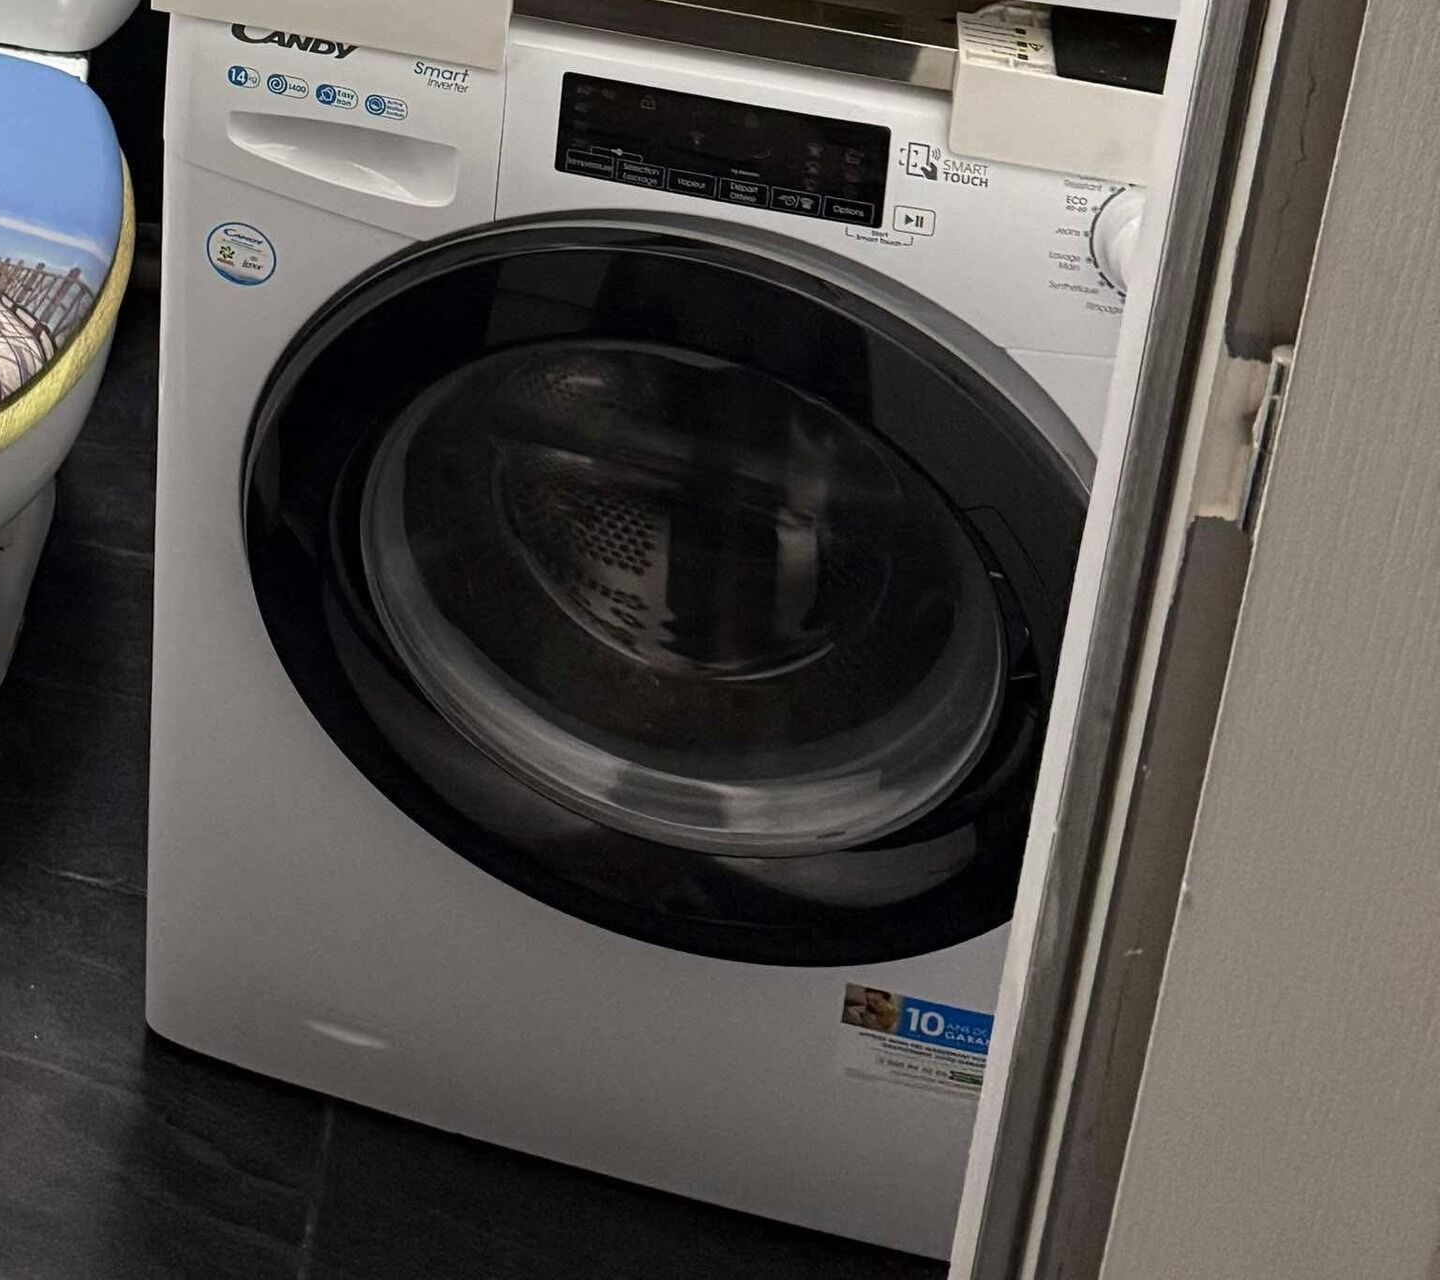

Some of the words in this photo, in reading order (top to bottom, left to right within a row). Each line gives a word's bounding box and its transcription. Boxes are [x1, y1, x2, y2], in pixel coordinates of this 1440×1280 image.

[231, 23, 360, 59] CANDY
[230, 68, 247, 83] 14
[413, 61, 470, 83] Smart
[427, 78, 469, 93] Inverter
[943, 159, 989, 176] SMART
[943, 171, 989, 188] TOUCH
[1066, 195, 1088, 205] ECO
[906, 1007, 945, 1036] 10
